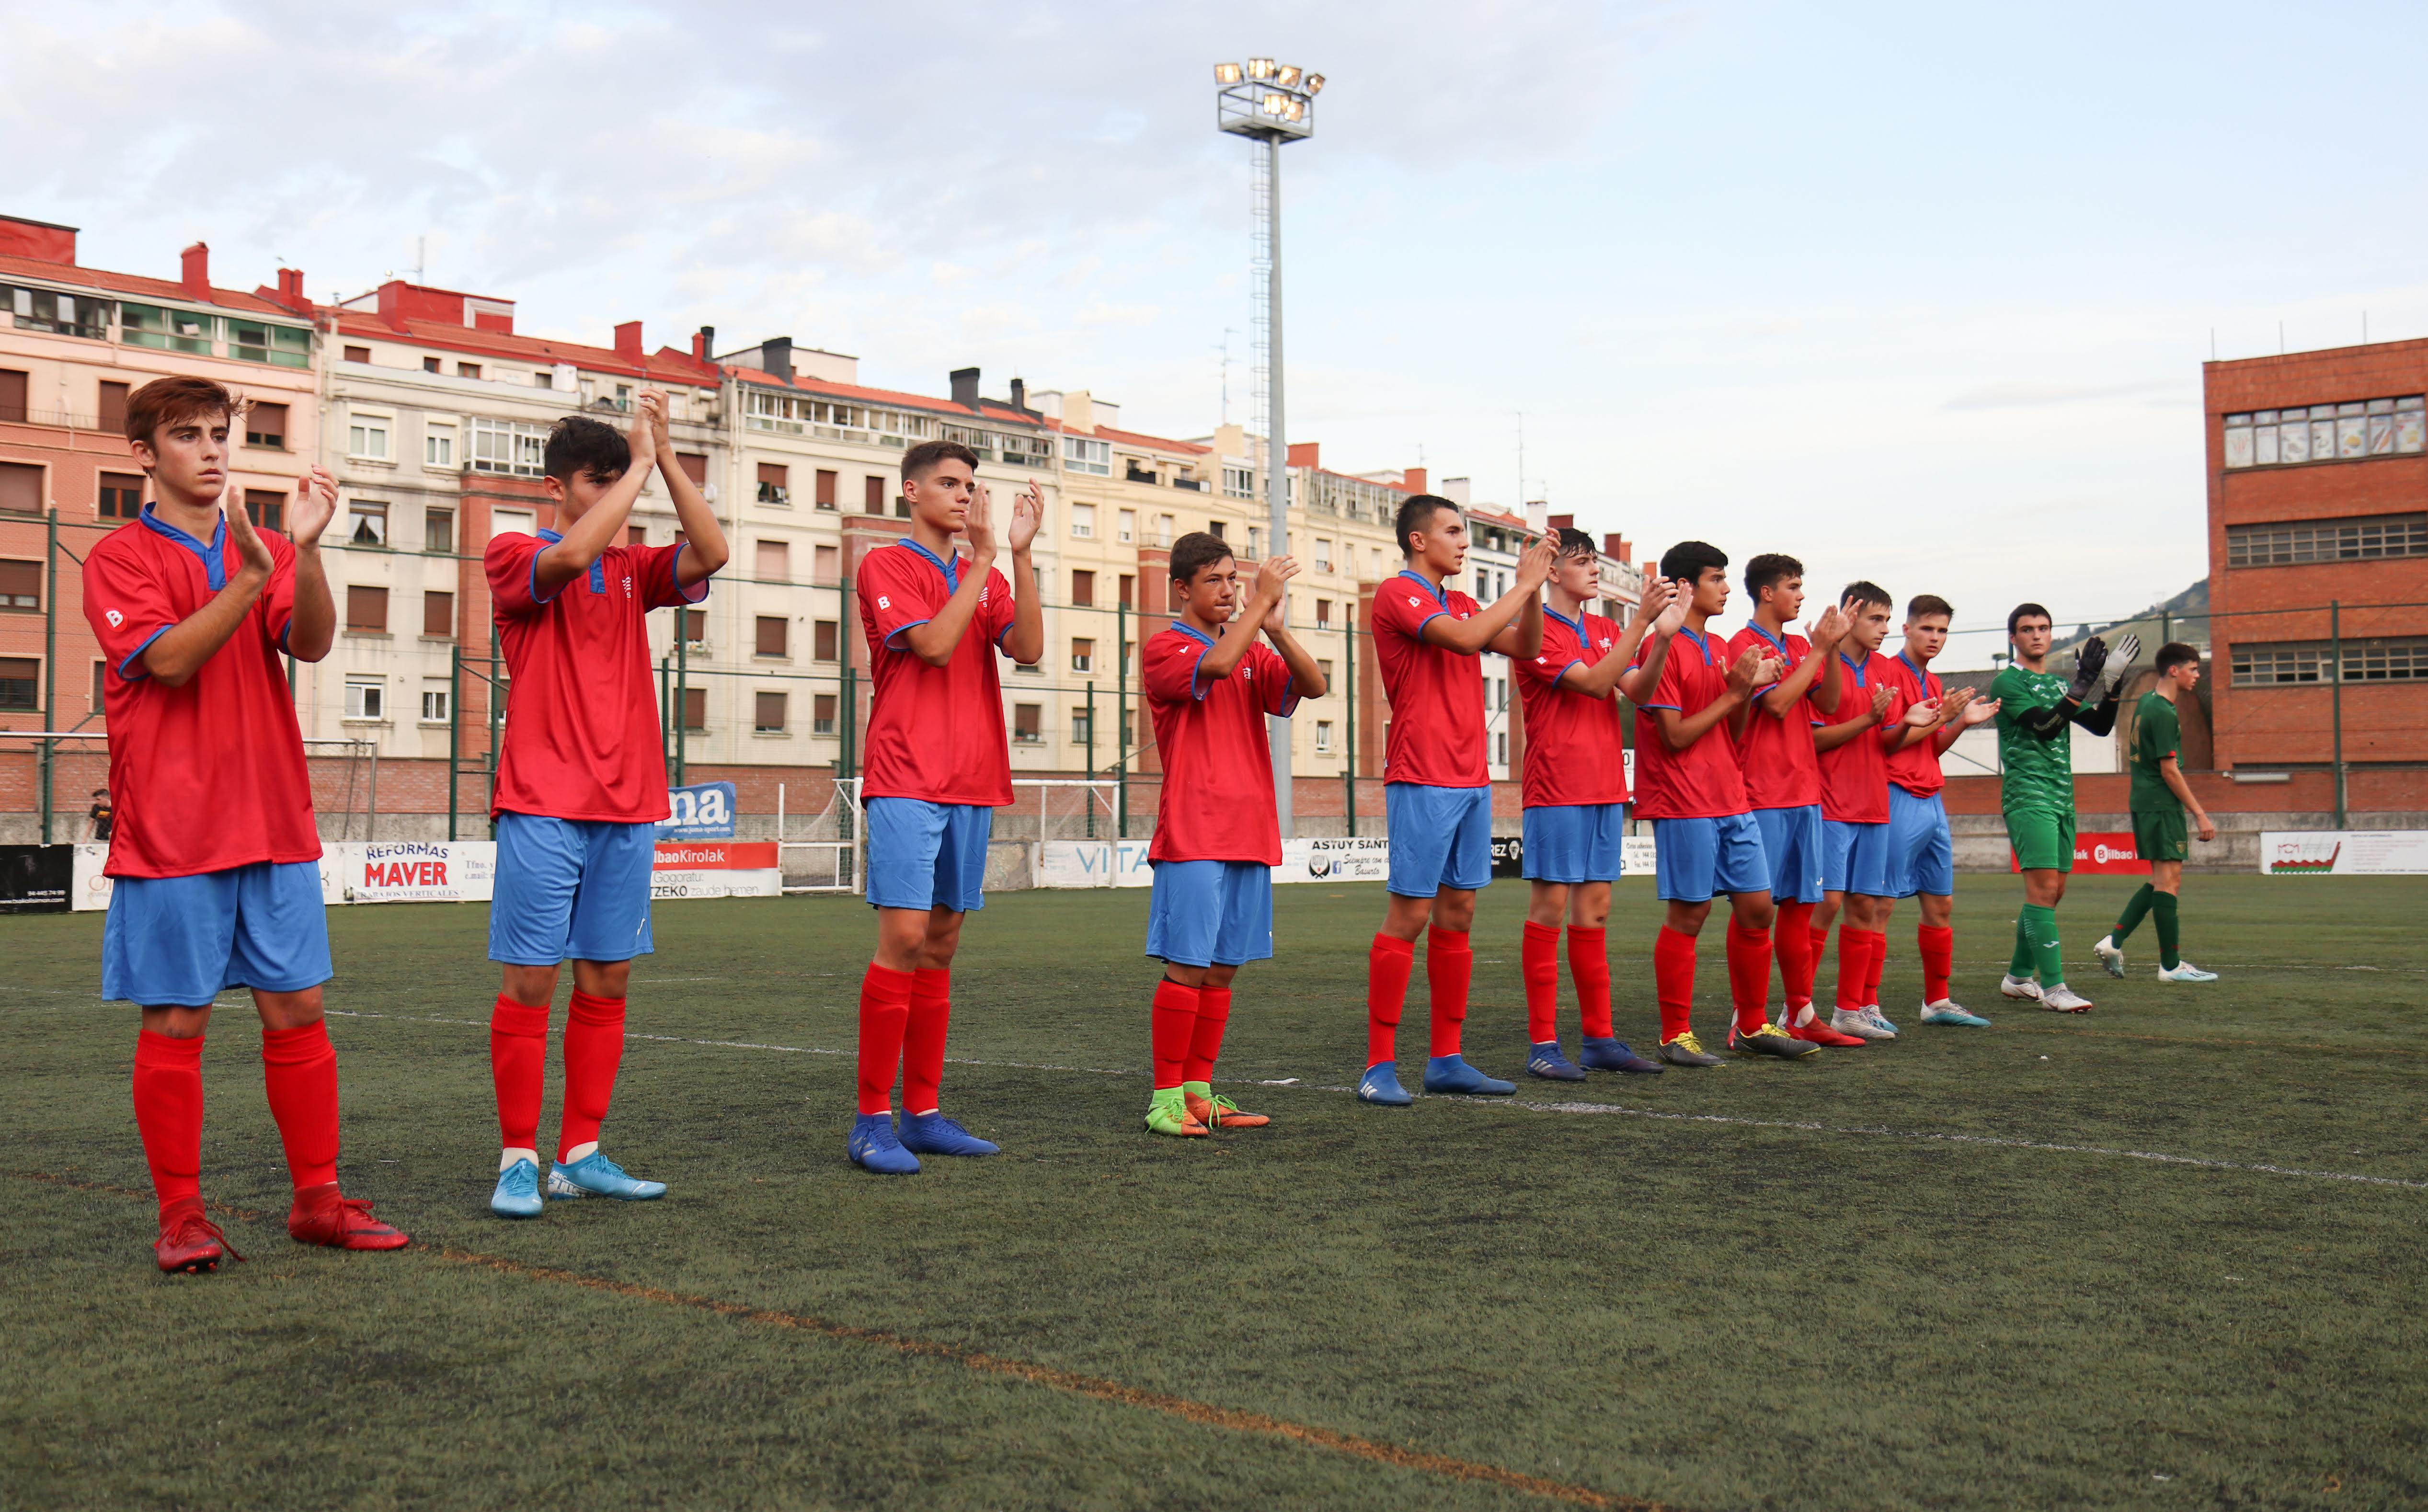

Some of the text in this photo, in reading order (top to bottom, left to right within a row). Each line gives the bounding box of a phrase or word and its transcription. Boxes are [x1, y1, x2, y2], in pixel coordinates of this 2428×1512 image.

[877, 596, 891, 610] B
[105, 610, 123, 628] B
[366, 843, 449, 860] REFORMAS
[1312, 840, 1354, 850] ASTUY
[1343, 853, 1371, 864] Siempre
[365, 862, 448, 887] MAVER
[1355, 864, 1380, 875] Basurto
[654, 871, 704, 885] Gogoratu:
